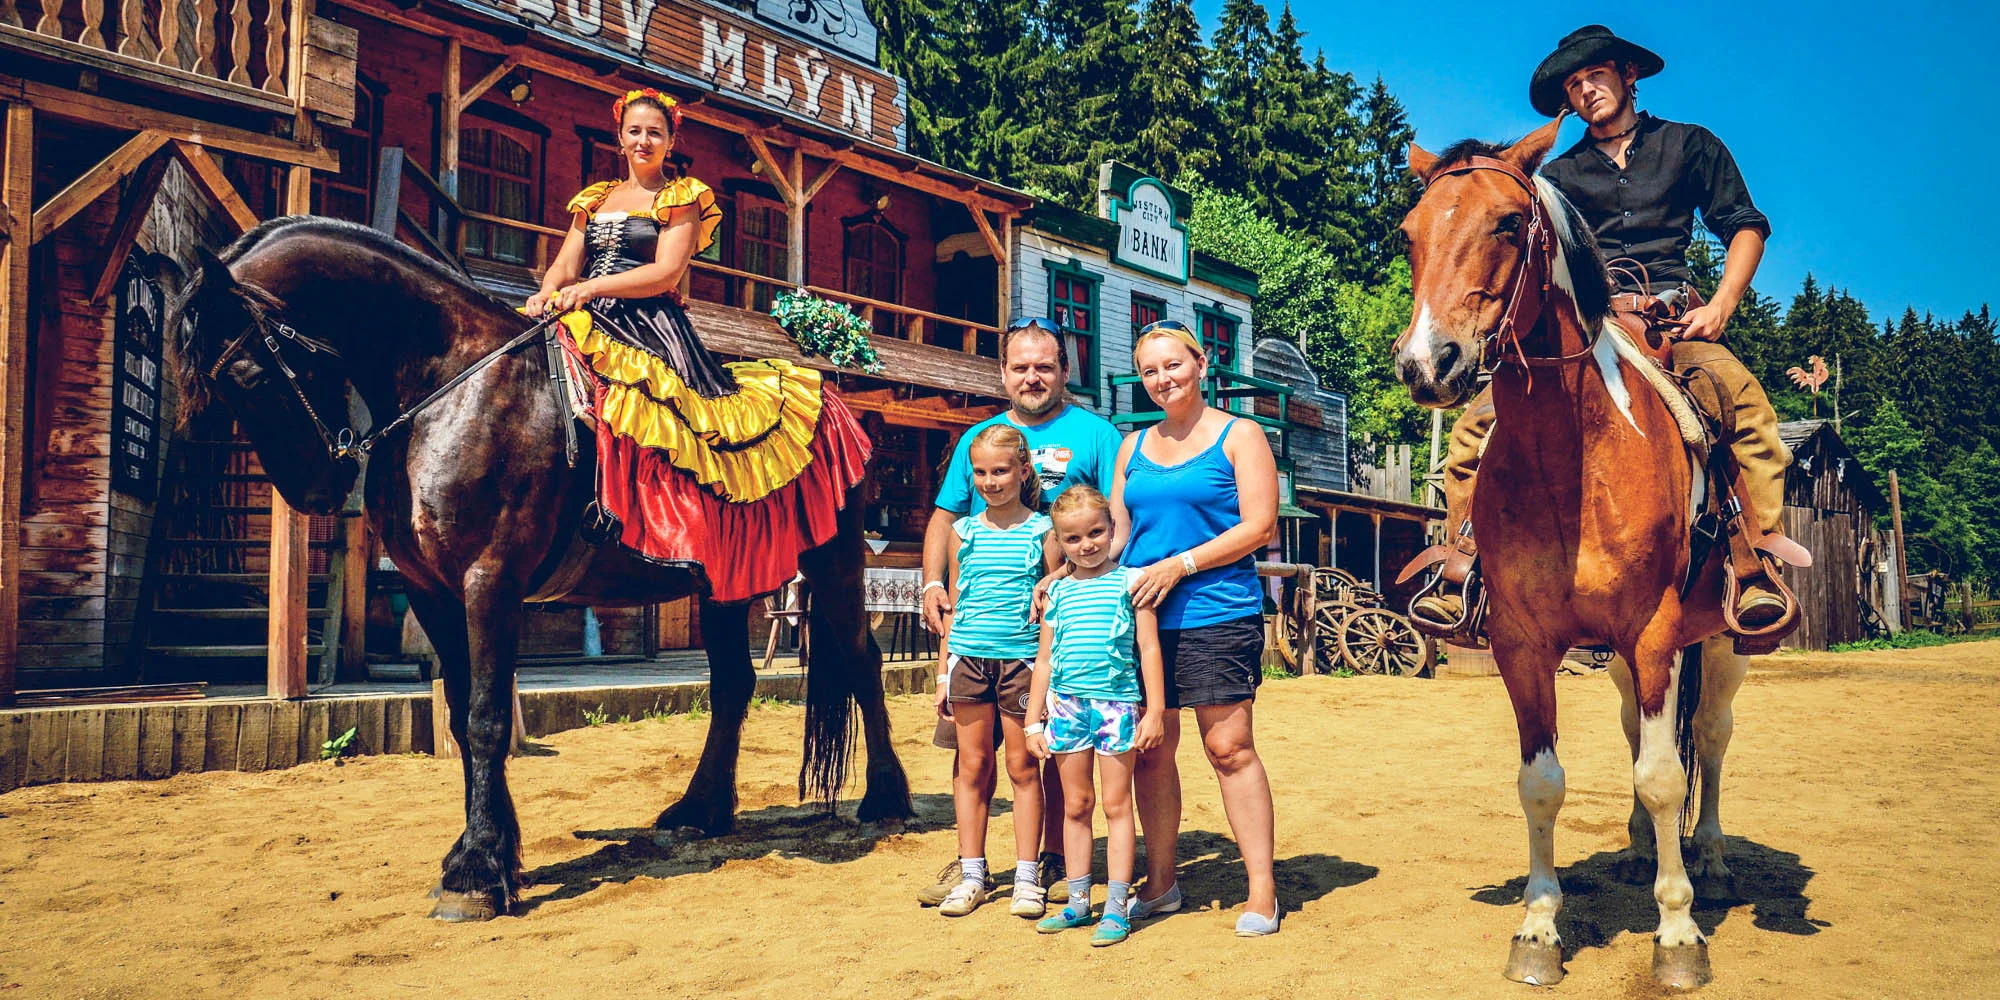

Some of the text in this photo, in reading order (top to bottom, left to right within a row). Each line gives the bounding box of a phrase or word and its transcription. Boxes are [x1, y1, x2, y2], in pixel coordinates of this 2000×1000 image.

[699, 15, 876, 140] MLÝN
[1142, 211, 1159, 224] CITY
[1132, 228, 1168, 262] BANK
